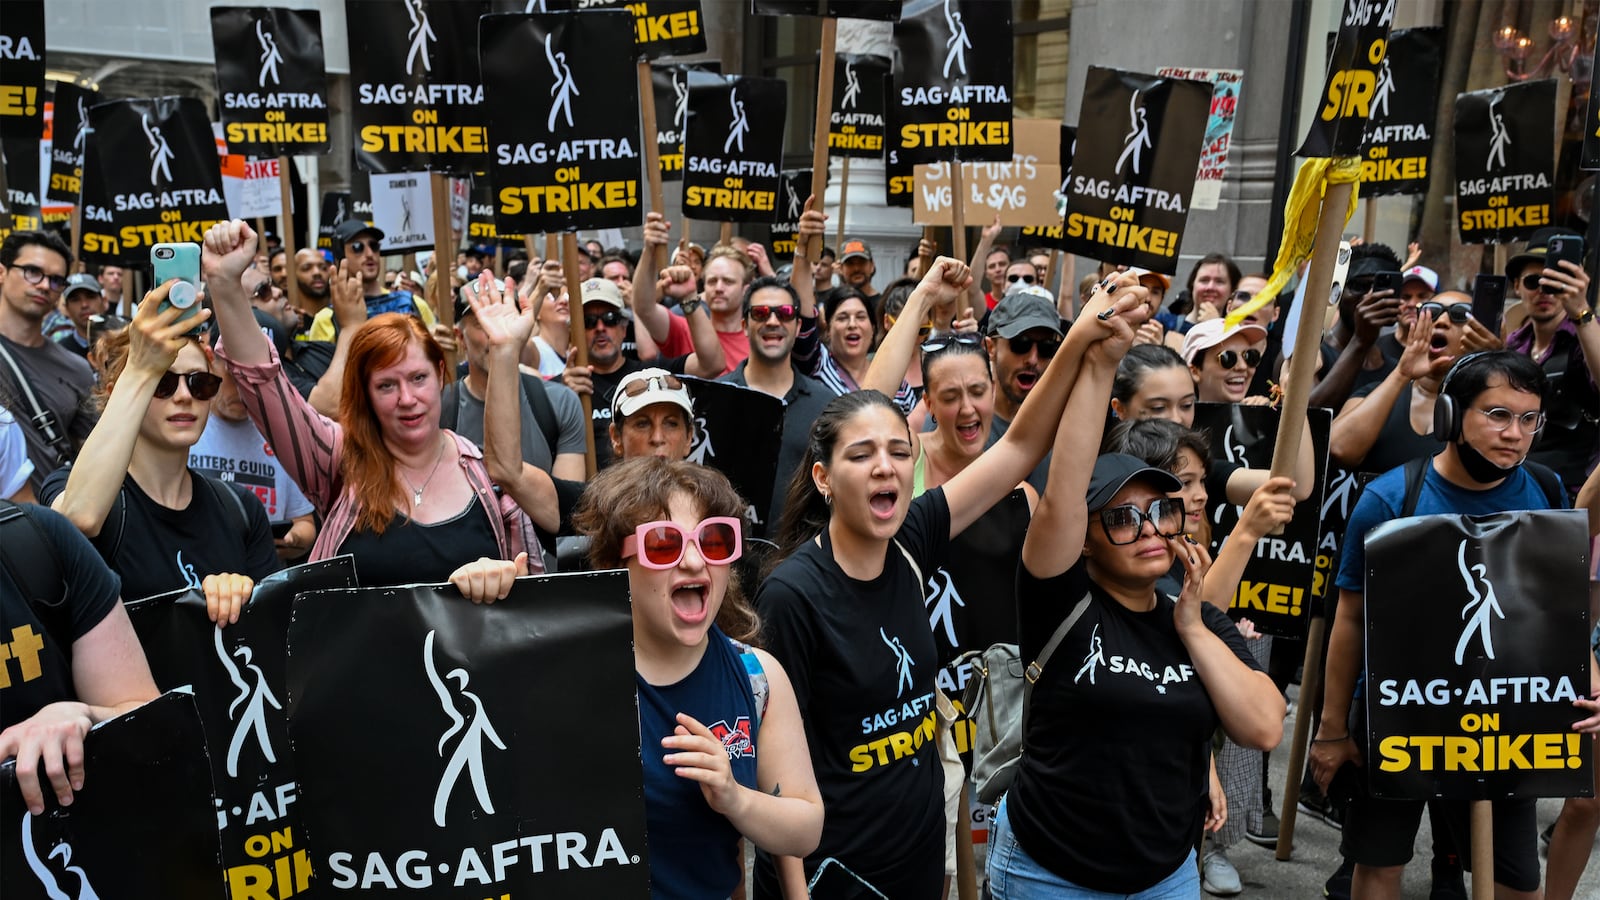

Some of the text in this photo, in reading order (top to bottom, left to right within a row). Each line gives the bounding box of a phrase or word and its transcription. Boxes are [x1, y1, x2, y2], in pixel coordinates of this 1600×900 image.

[265, 110, 286, 123] ON
[412, 109, 438, 124] ON
[947, 107, 970, 121] ON
[226, 122, 327, 143] STRIKE!
[841, 125, 856, 134] ON
[901, 121, 1010, 149] STRIKE!
[360, 125, 489, 153] STRIKE!
[1369, 147, 1388, 159] ON
[555, 166, 580, 184] ON
[723, 177, 743, 188] ON
[499, 180, 637, 215] STRIKE!
[686, 186, 776, 211] STRIKE!
[987, 182, 1027, 210] SAG
[1488, 196, 1508, 207] ON
[161, 210, 181, 222] ON
[1109, 206, 1134, 222] ON
[1461, 204, 1550, 230] STRIKE!
[1066, 213, 1178, 258] STRIKE!
[220, 471, 235, 482] ON
[239, 460, 275, 477] GUILD
[1460, 713, 1500, 732] ON
[1379, 733, 1582, 772] STRIKE!
[245, 826, 293, 858] ON
